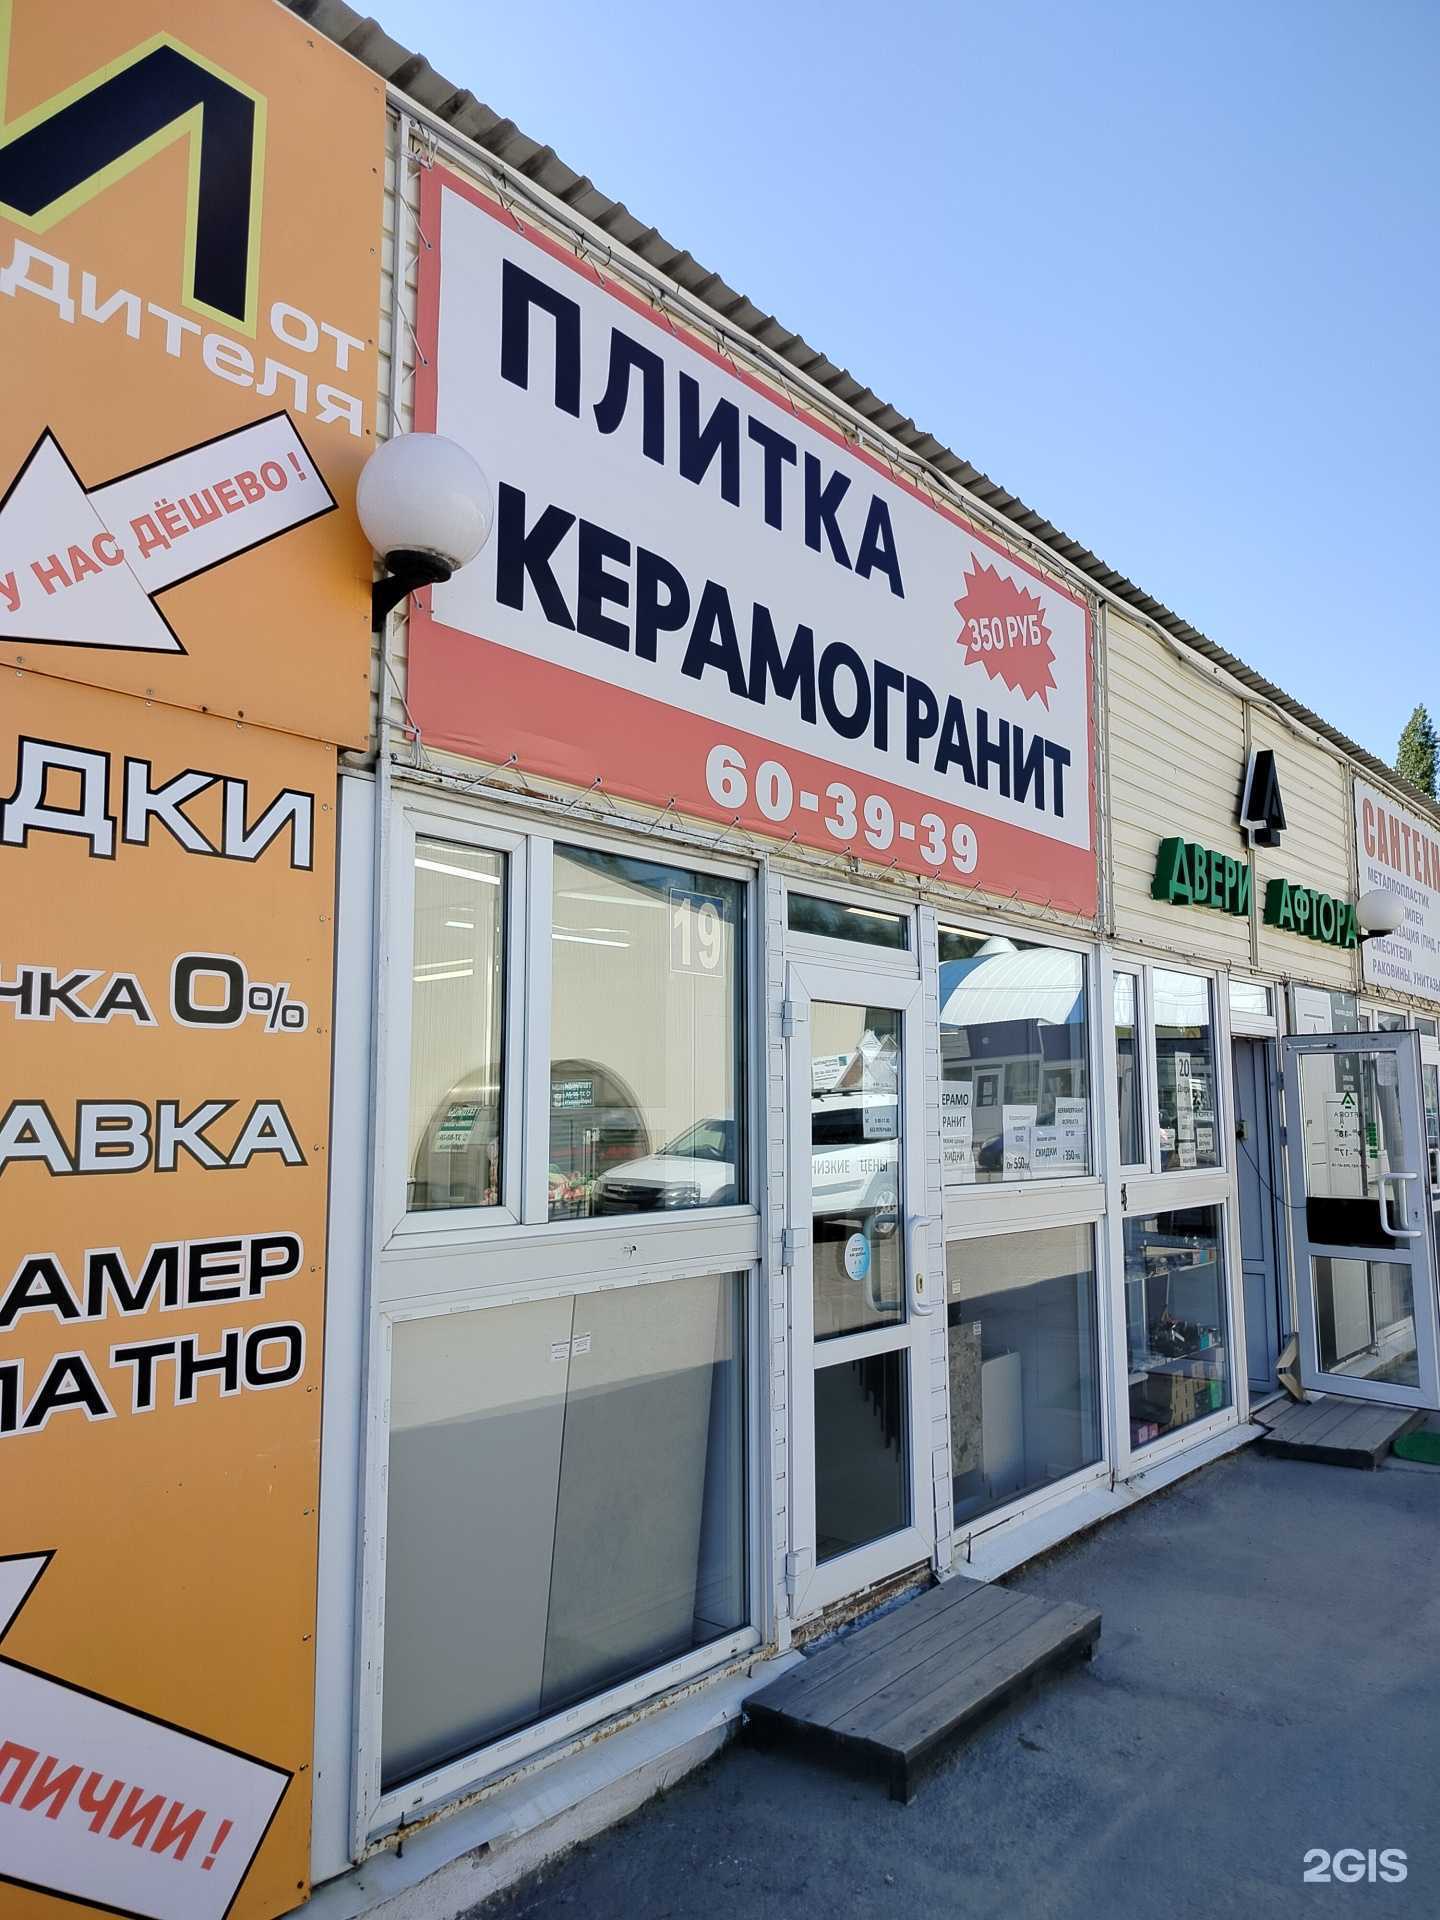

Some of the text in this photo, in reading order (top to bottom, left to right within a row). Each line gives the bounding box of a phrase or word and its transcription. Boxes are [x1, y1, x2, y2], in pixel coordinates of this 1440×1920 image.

[270, 302, 365, 371] от
[500, 257, 905, 600] ПЛИТКА
[30, 532, 125, 595] НАС
[496, 480, 1071, 819] КЕРАМОГРАНИТ
[968, 614, 1041, 652] 350 РУБ
[0, 734, 315, 873] ДКИ
[705, 743, 978, 874] 60-39-39
[1154, 837, 1250, 917] ДВЕРИ
[1267, 879, 1358, 949] АФТОРА
[674, 898, 721, 970] 19
[169, 951, 309, 1033] 0%
[1179, 1059, 1190, 1077] 20
[0, 1098, 309, 1178] АВКА
[860, 1158, 888, 1176] ЦЕНЫ
[0, 1230, 304, 1332] АМЕР
